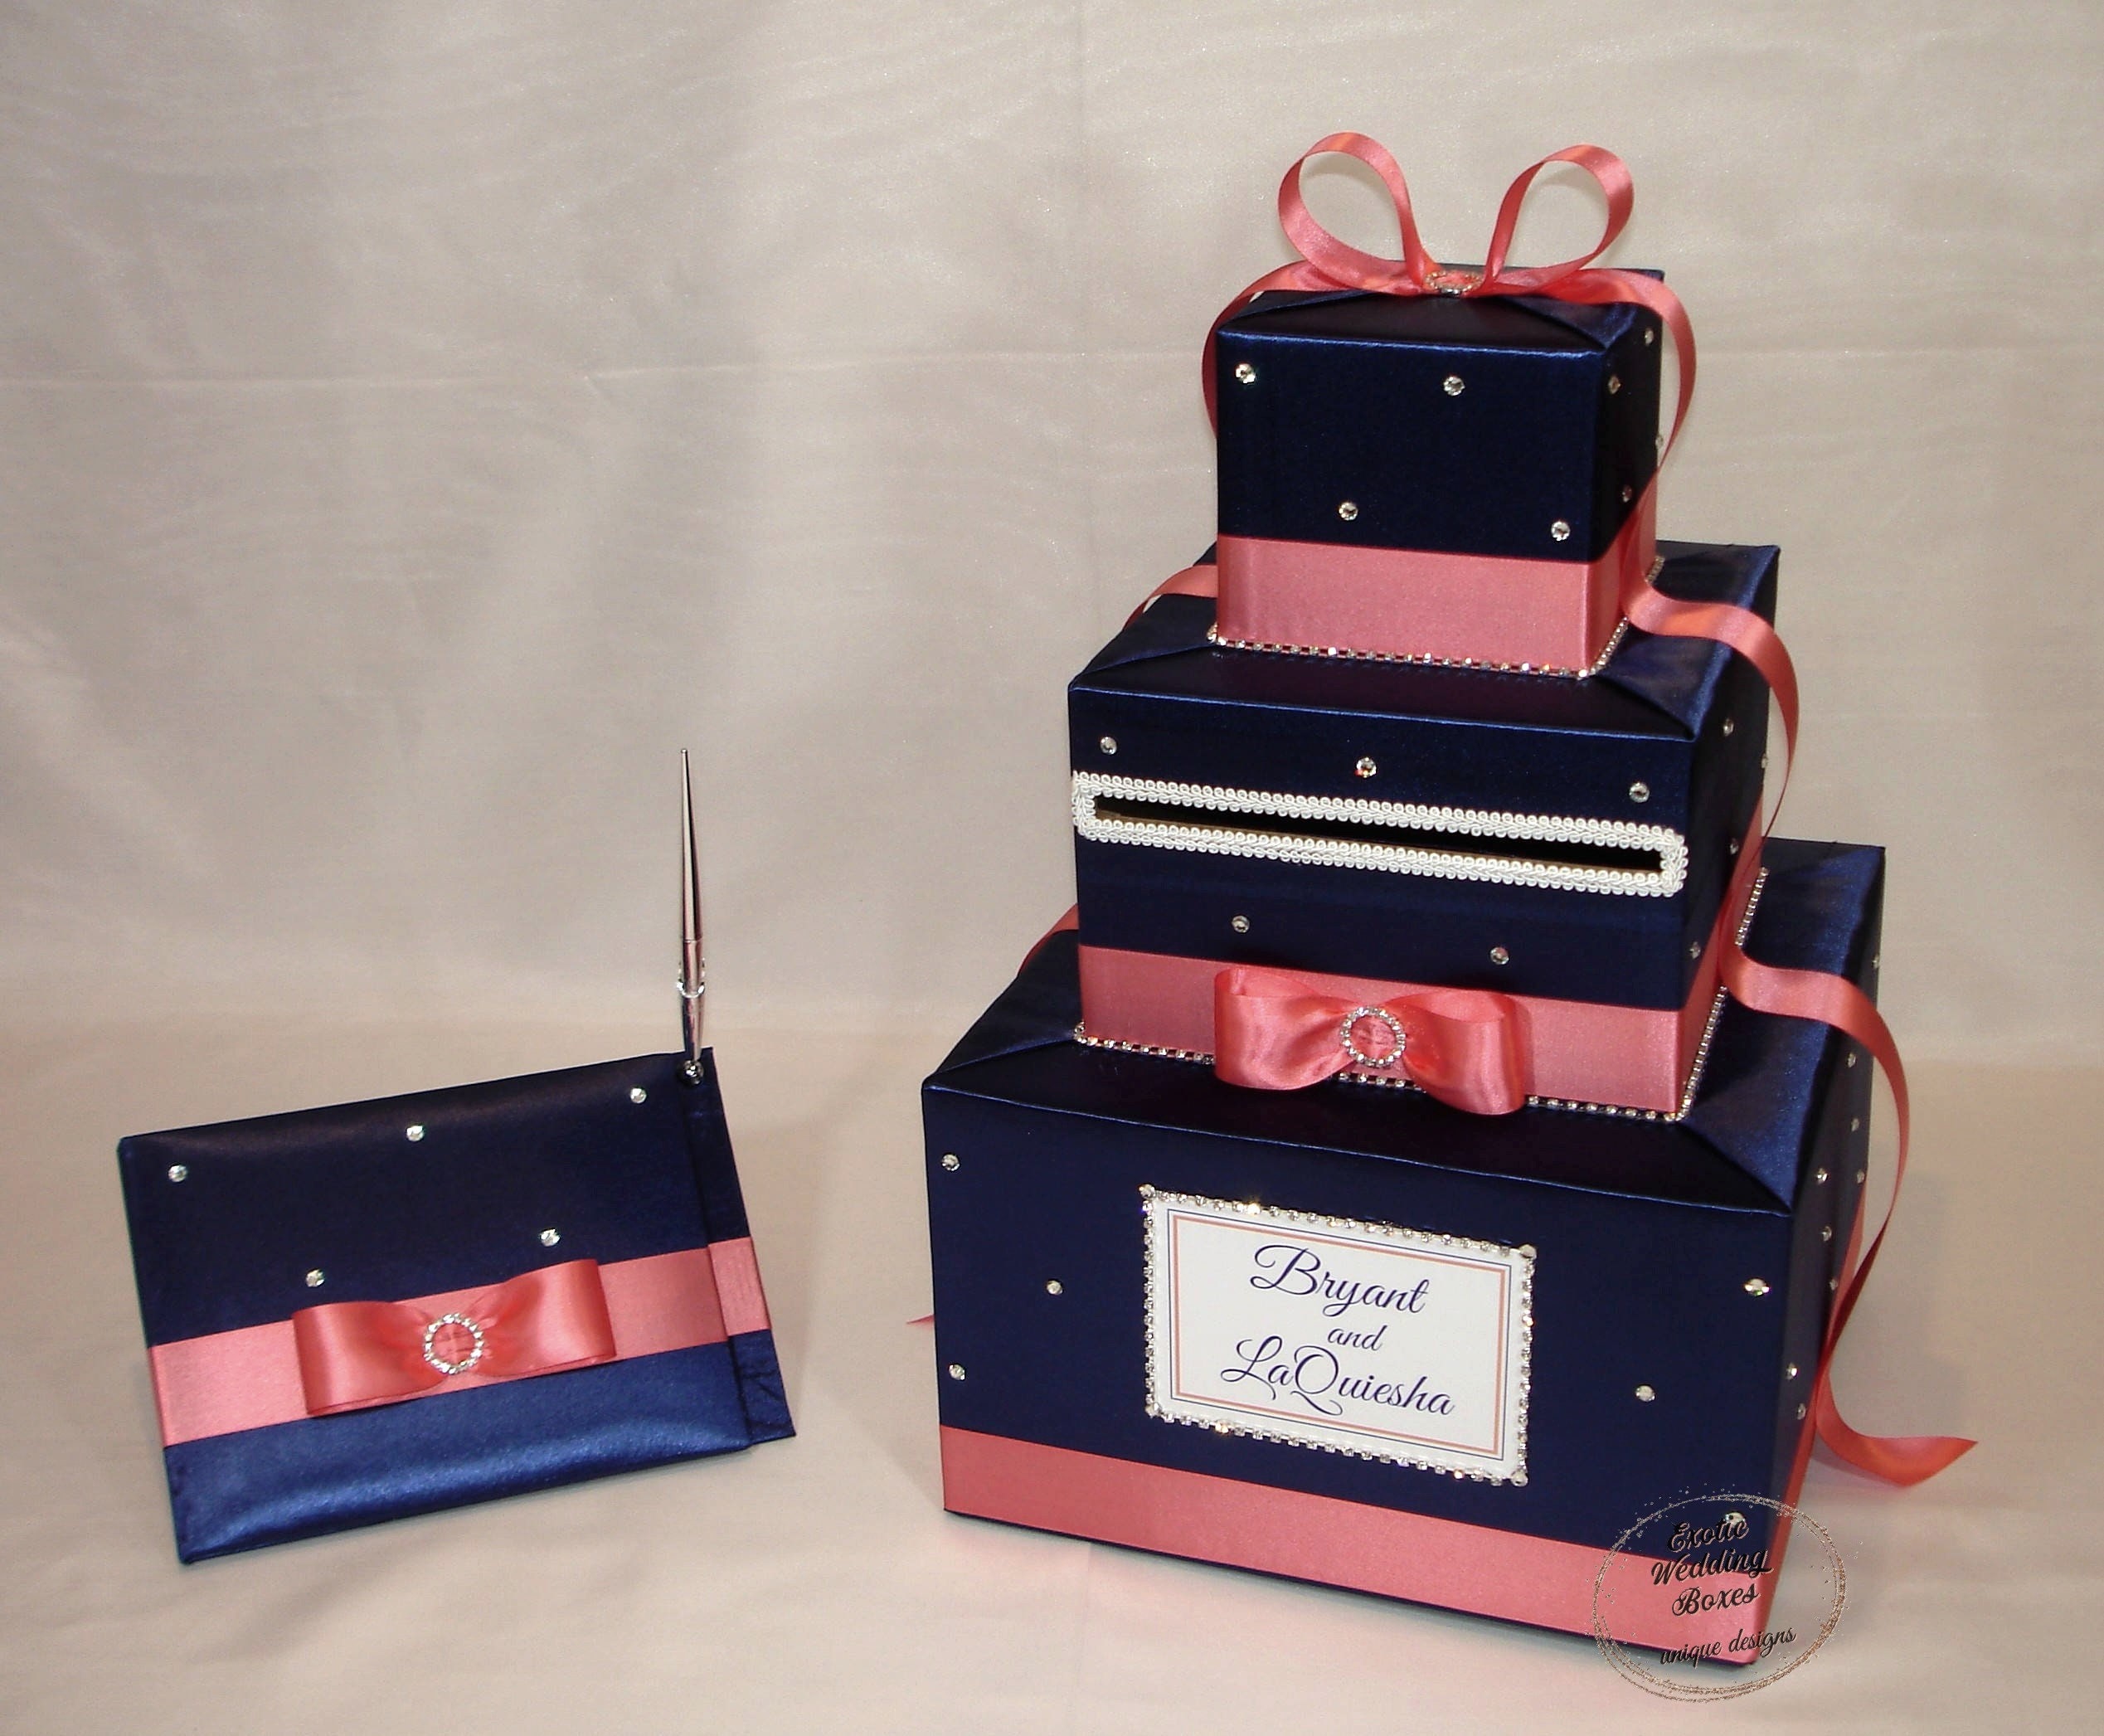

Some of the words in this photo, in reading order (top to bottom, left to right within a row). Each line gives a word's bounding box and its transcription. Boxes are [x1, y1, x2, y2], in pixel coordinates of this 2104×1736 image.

[1250, 1245, 1429, 1317] Bryant
[1327, 1325, 1387, 1351] and
[1221, 1335, 1455, 1416] LaQuiesha
